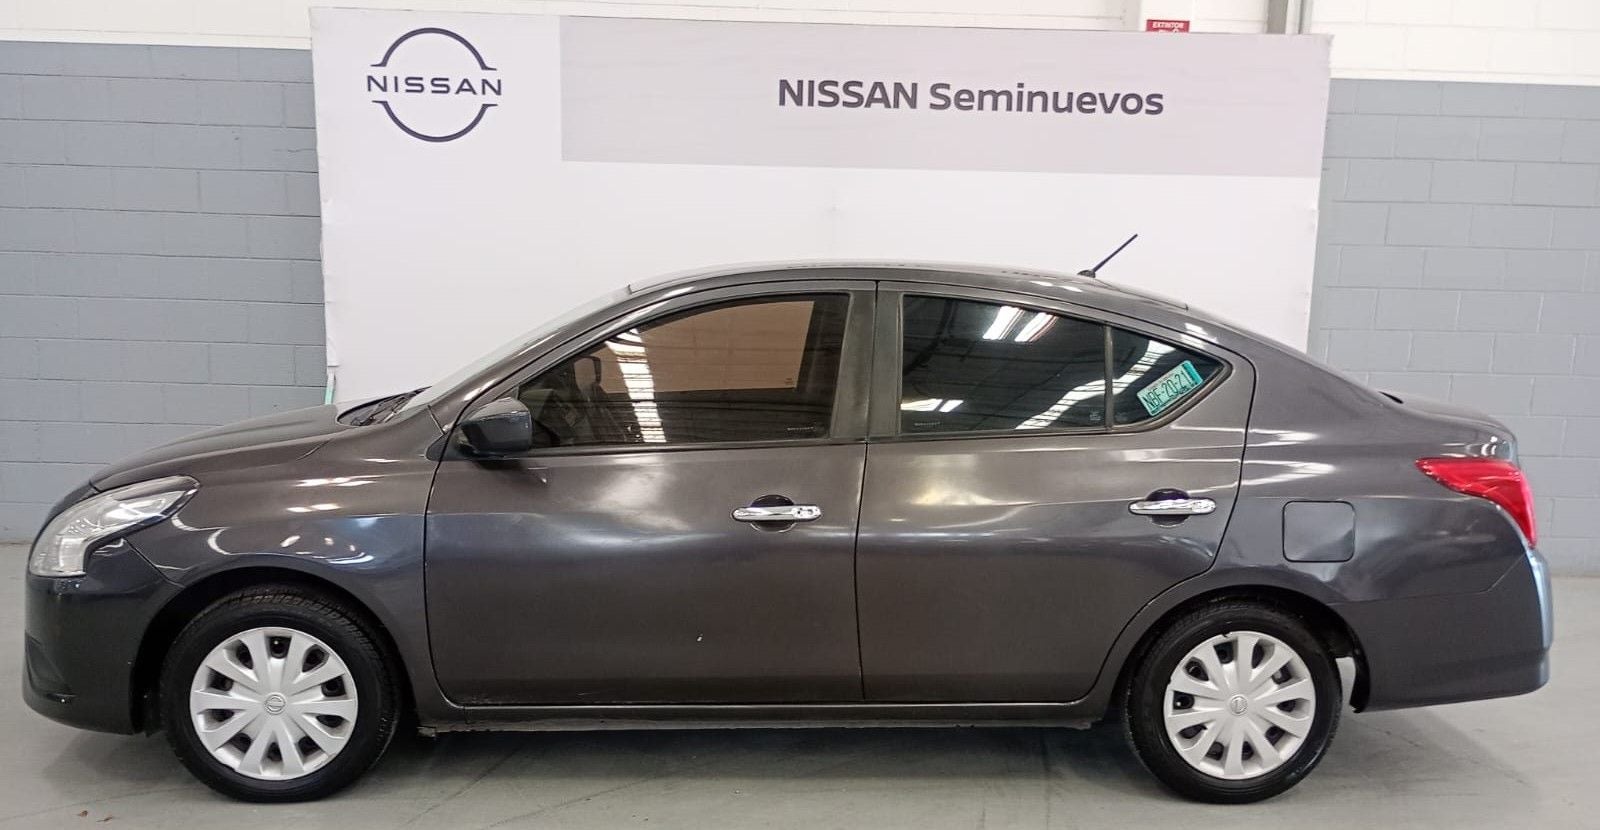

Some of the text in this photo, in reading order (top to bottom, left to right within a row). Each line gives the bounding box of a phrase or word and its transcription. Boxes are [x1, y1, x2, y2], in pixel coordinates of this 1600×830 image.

[367, 75, 503, 96] NISSAN
[778, 79, 1164, 116] NISSAN Seminuevos
